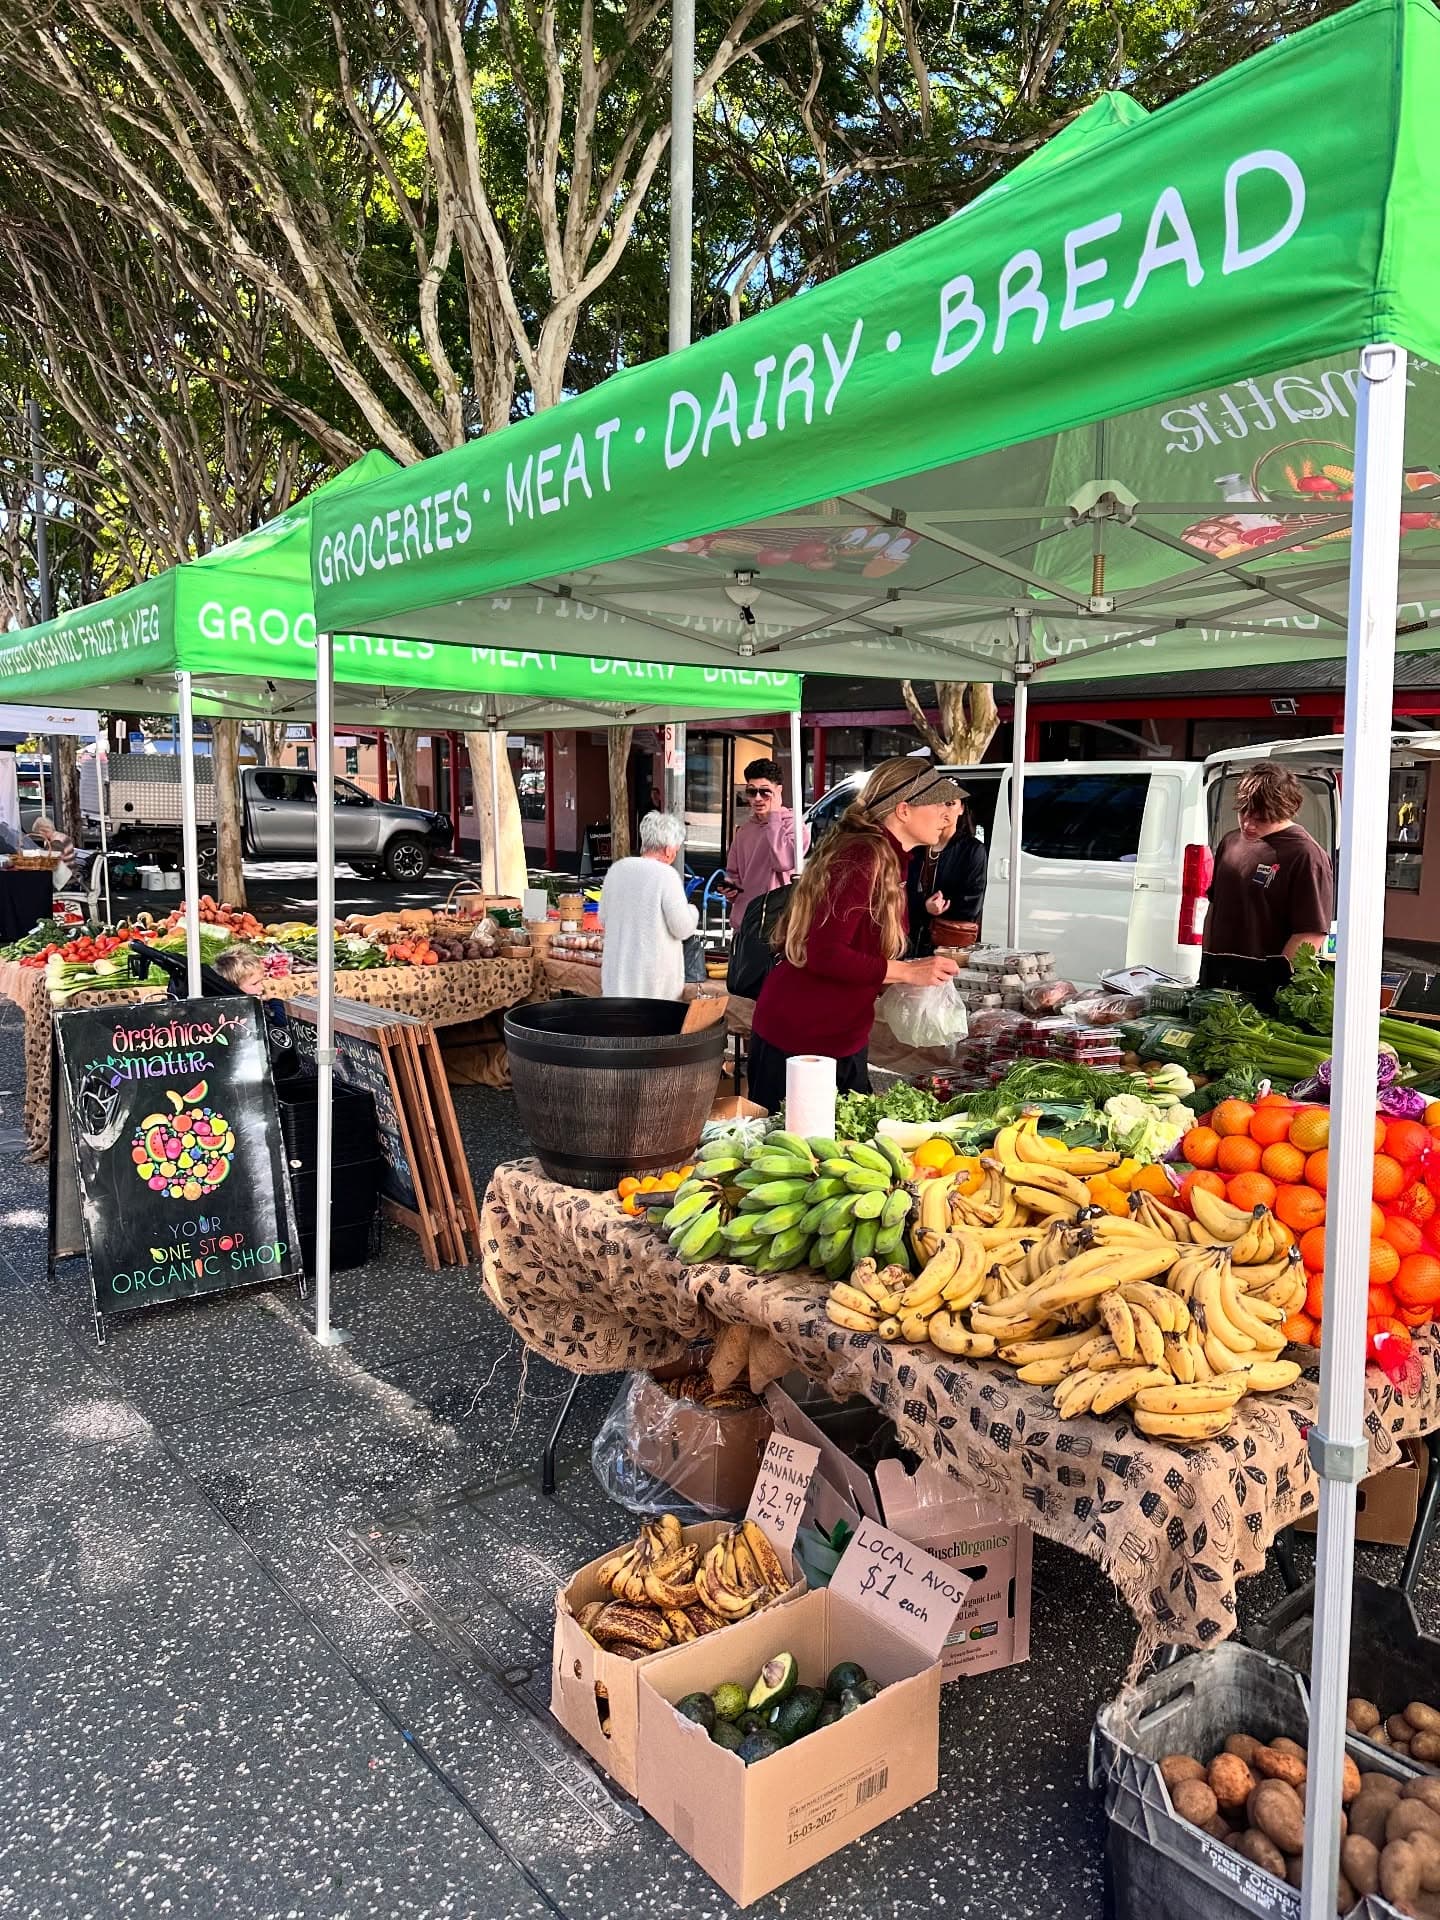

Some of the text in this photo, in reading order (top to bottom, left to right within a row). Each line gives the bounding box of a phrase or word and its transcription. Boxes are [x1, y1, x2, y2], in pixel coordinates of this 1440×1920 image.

[318, 149, 1306, 585] GROCERIES MEAT DAIRY BREAD
[0, 643, 32, 677] TIFIED
[27, 629, 82, 671] ORGANIC
[77, 618, 118, 659] FRUIT
[129, 604, 160, 647] VEG
[198, 601, 435, 660] GROCIES
[150, 1233, 244, 1264] ONE STOP
[169, 1215, 222, 1239] YOUR
[112, 1241, 288, 1294] ORGANIC SHOP
[762, 1459, 811, 1488] BANANAS
[768, 1441, 795, 1462] RIPE
[757, 1480, 802, 1516] $2.99
[857, 1531, 964, 1603] LOCAL AVOS
[860, 1563, 928, 1622] $1 each
[1201, 1840, 1242, 1875] Forest
